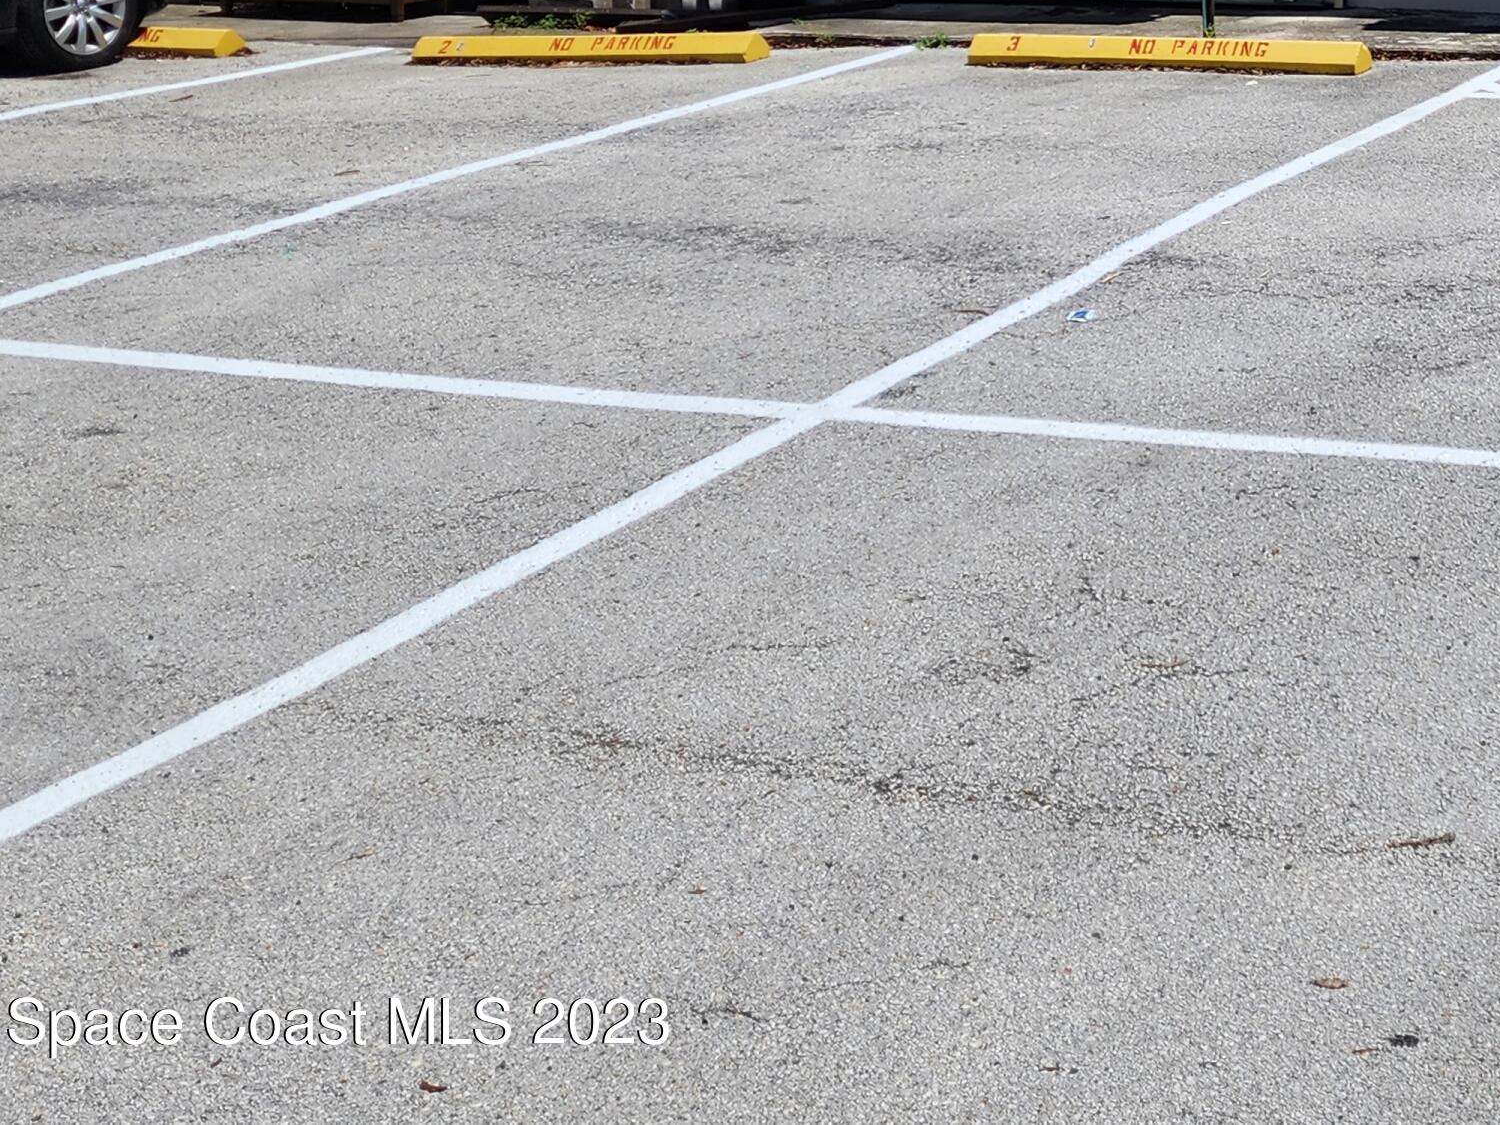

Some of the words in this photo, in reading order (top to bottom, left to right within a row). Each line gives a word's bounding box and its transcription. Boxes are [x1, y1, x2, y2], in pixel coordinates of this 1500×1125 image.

[438, 40, 452, 54] 2
[549, 38, 575, 51] NO
[590, 36, 677, 51] PARKING
[1006, 36, 1021, 51] 3
[1129, 39, 1156, 54] NO
[1172, 40, 1269, 57] PARKING
